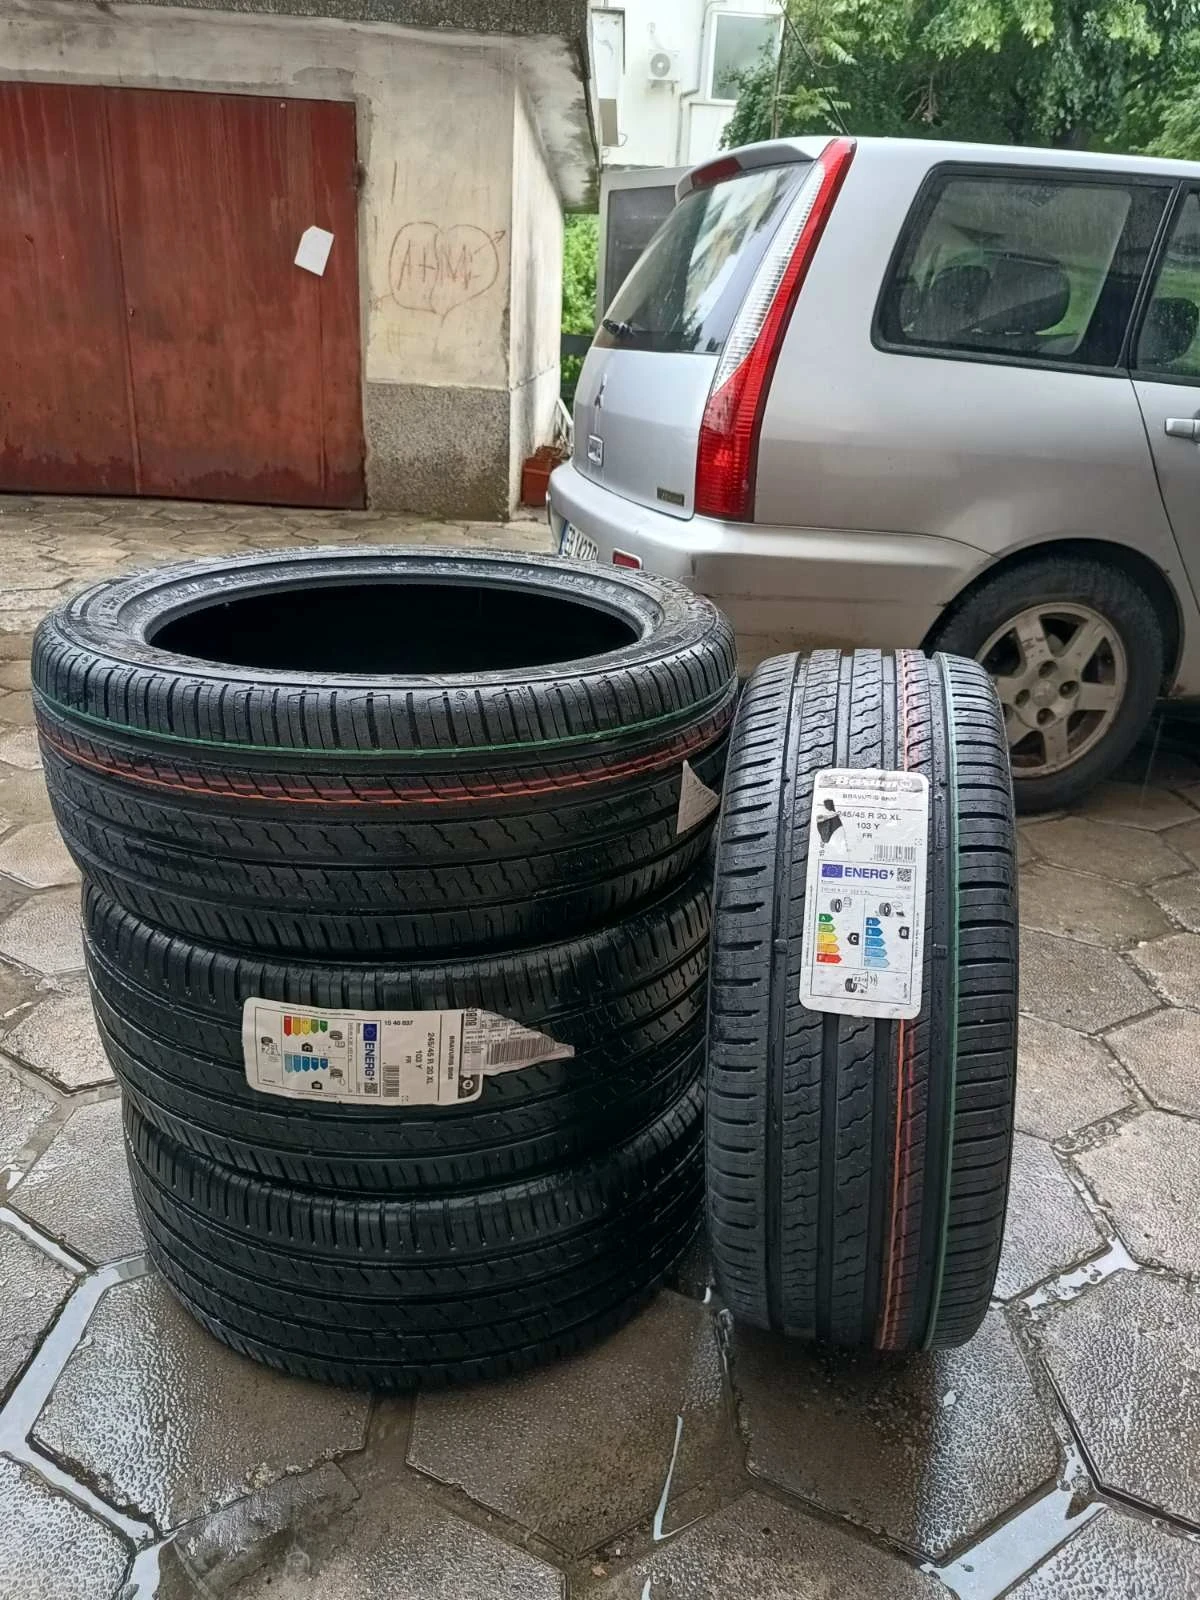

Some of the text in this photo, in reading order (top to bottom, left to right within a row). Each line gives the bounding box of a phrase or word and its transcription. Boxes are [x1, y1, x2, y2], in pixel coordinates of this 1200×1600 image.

[876, 812, 888, 820] 20
[889, 813, 903, 821] XL
[857, 822, 872, 830] 103
[844, 866, 889, 880] ENERG
[426, 1032, 435, 1058] 245/45
[364, 1042, 375, 1077] ENERG
[415, 1050, 423, 1063] 103
[426, 1066, 434, 1075] 20
[426, 1076, 434, 1085] XL
